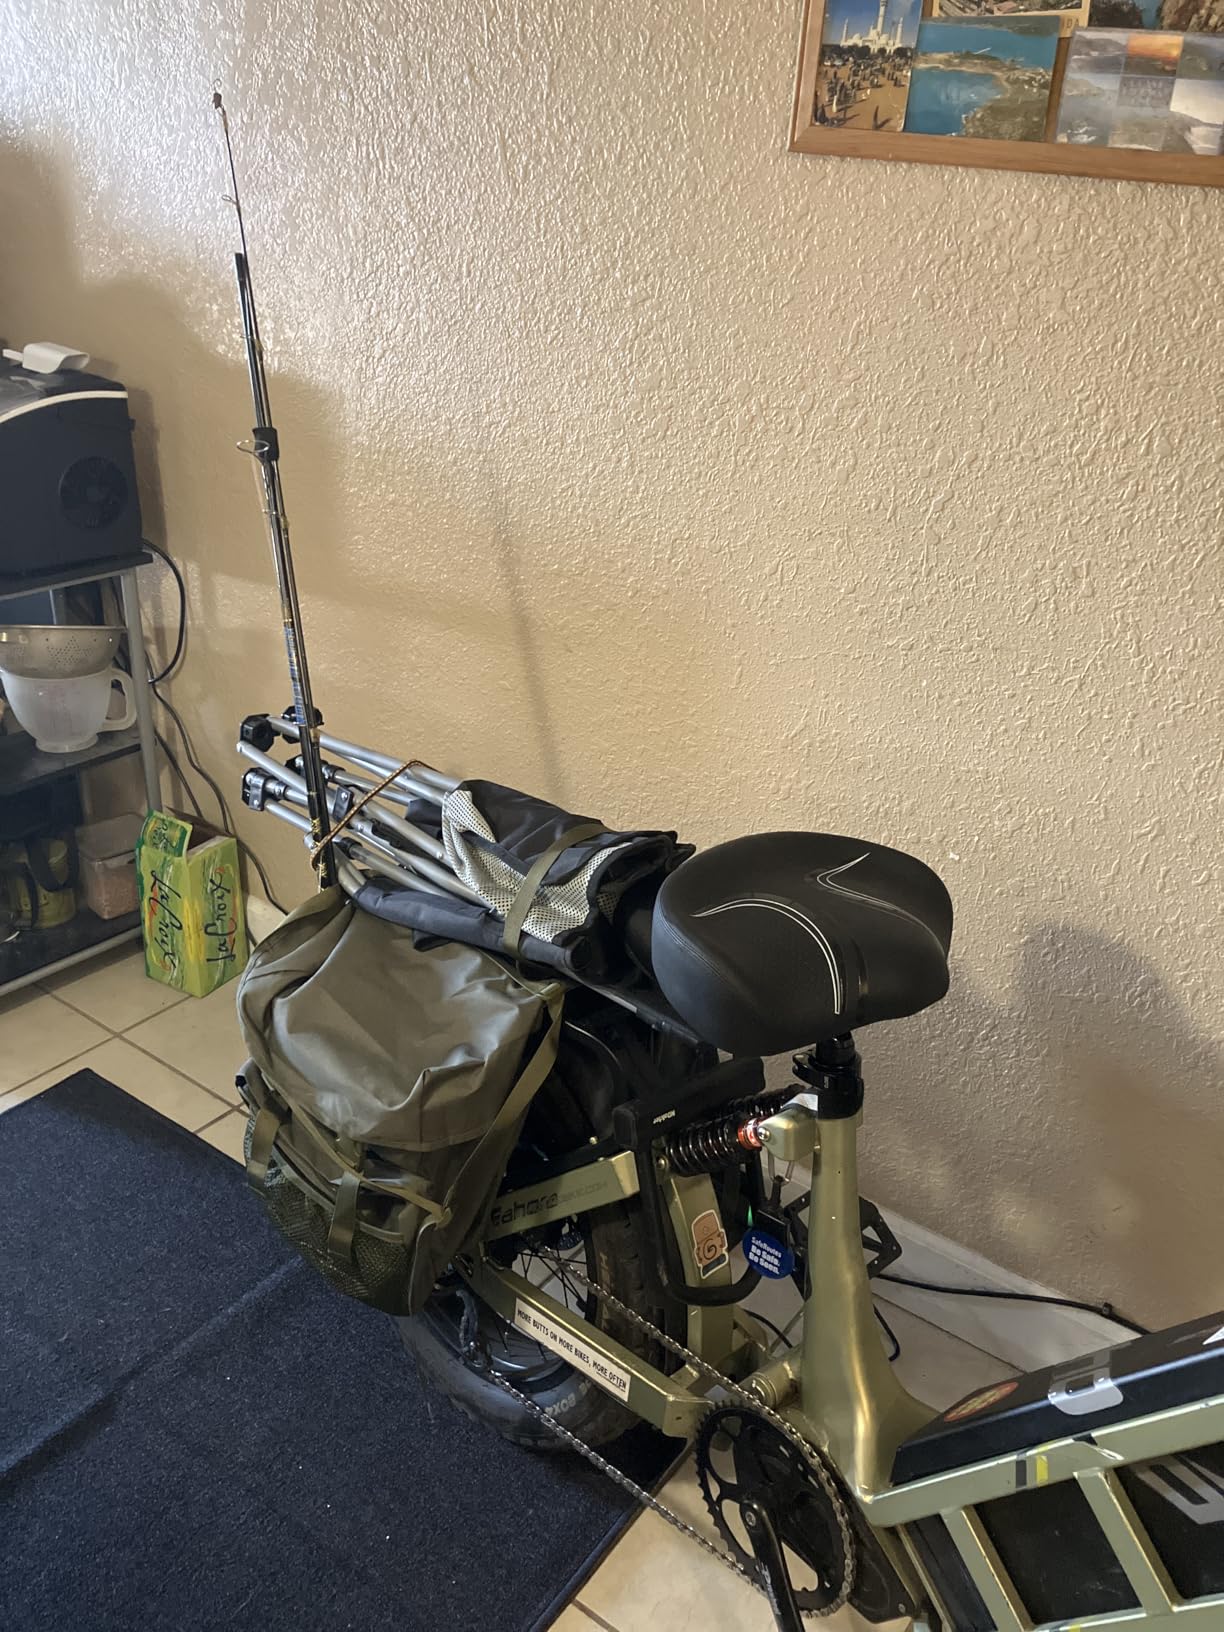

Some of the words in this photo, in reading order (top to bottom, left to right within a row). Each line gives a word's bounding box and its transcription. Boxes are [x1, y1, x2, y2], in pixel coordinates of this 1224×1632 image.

[150, 870, 183, 969] LaCroix
[204, 873, 237, 962] LaCroix
[517, 1310, 531, 1324] MORE
[532, 1319, 549, 1336] BUTTS
[549, 1331, 558, 1343] ON
[558, 1337, 573, 1353] MORE
[574, 1348, 591, 1367] BIKES,
[592, 1362, 608, 1377] MORE
[608, 1373, 627, 1390] OFTEN
